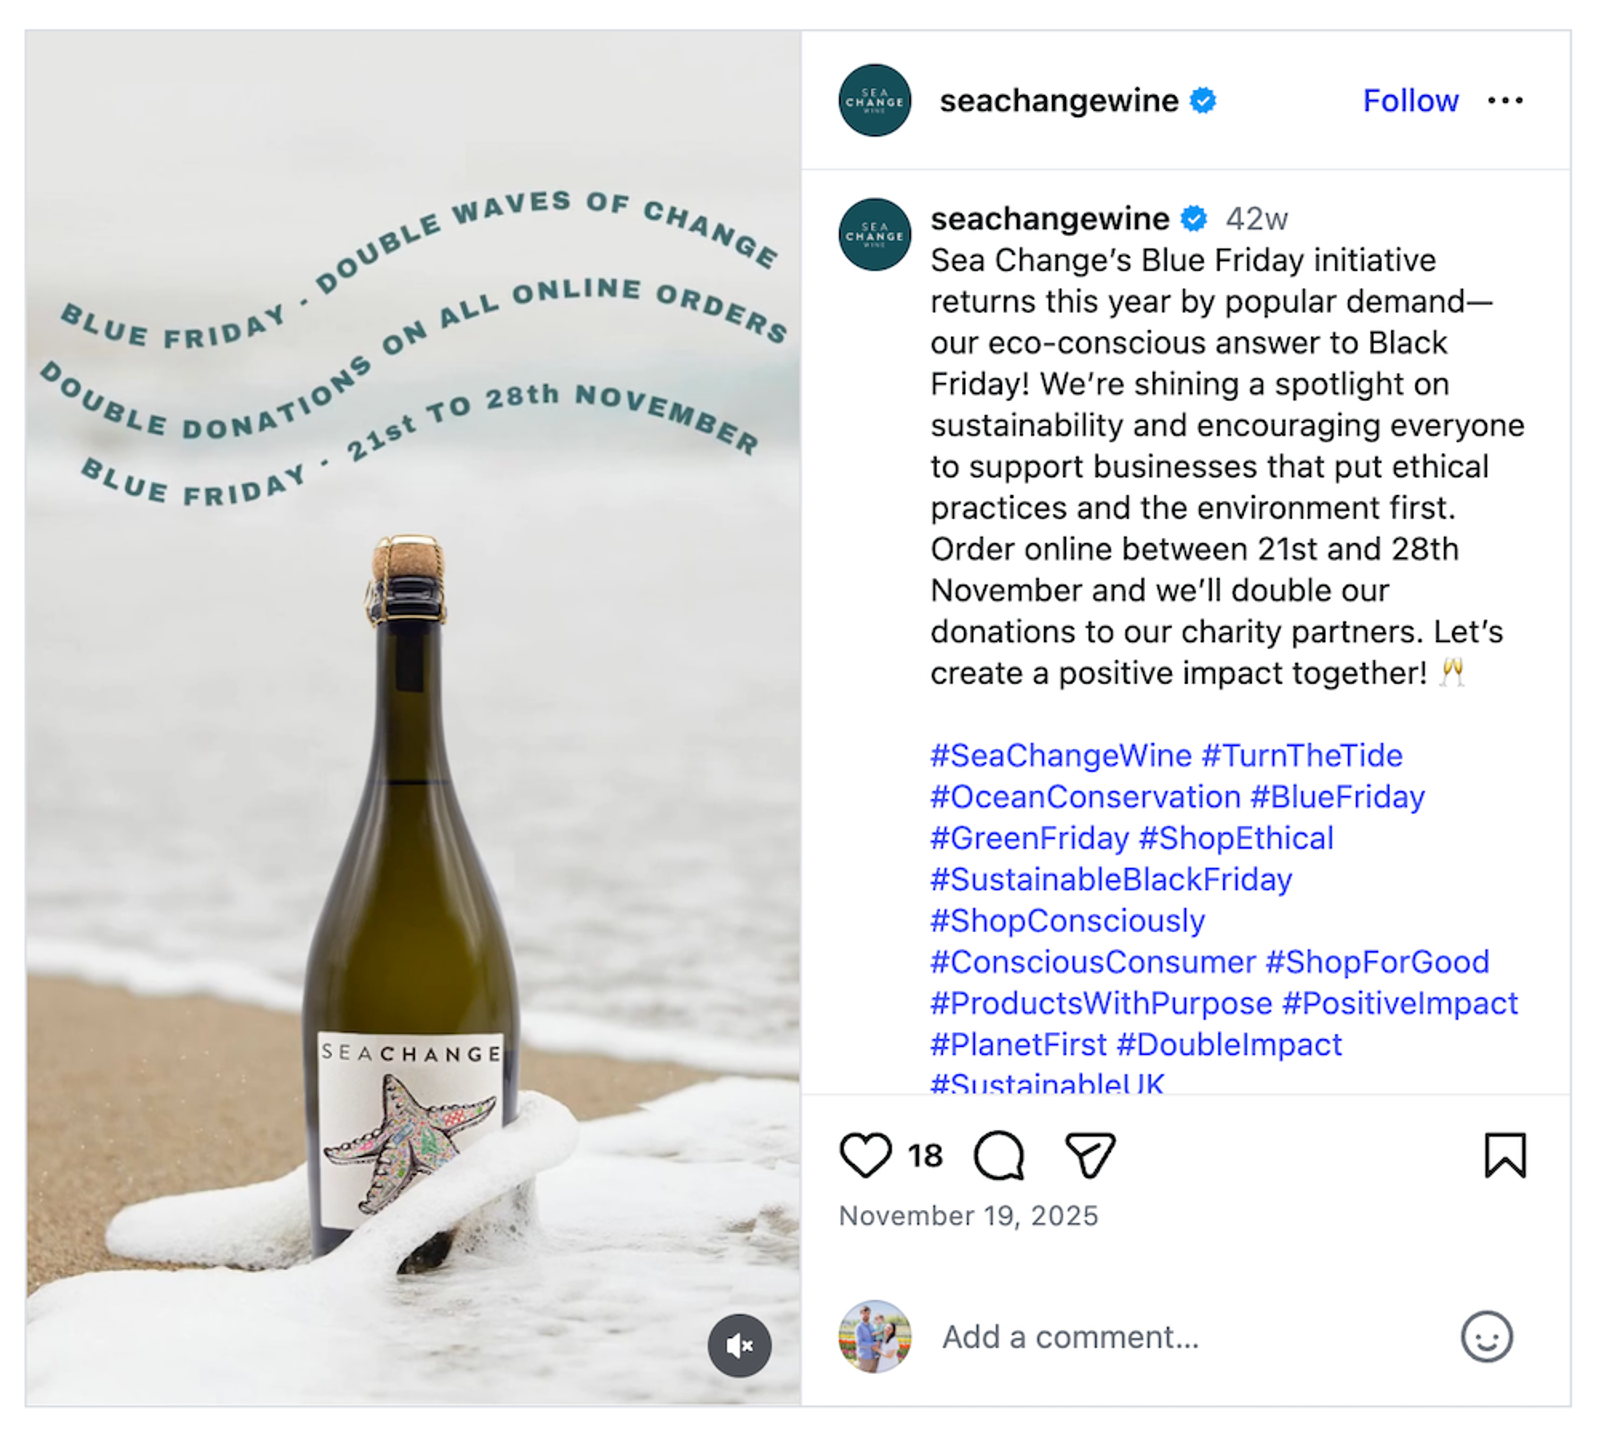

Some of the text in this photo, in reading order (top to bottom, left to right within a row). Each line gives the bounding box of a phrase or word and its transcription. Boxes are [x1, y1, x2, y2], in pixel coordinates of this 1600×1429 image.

[845, 98, 904, 107] CHANGE
[861, 88, 889, 97] SEA
[940, 86, 1179, 118] seachangewine
[1365, 87, 1460, 113] Follow
[861, 222, 889, 231] SEA
[931, 204, 1288, 236] seachangewine 42w
[845, 232, 904, 241] CHANGE
[931, 247, 984, 272] Sea
[1143, 247, 1205, 272] Blue
[1216, 246, 1305, 278] Friday
[1315, 246, 1436, 272] initiative
[932, 290, 1036, 313] returns
[1045, 288, 1098, 313] this
[1108, 294, 1171, 319] year
[1182, 288, 1216, 319] by
[1226, 288, 1337, 319] popular
[931, 329, 1448, 355] our eco-conscious answer to Black
[932, 370, 1029, 401] Friday!
[1135, 370, 1238, 401] shining
[1249, 377, 1264, 396] a
[1276, 370, 1404, 401] spotlight
[1414, 377, 1449, 396] on
[931, 412, 1525, 443] sustainability and encouraging everyone
[930, 453, 1488, 484] to support businesses that put ethical
[932, 494, 1455, 525] practices and the environment first.
[931, 536, 1459, 561] Order online between 21st and 28th
[932, 577, 1083, 602] November
[1093, 577, 1145, 602] and
[1232, 577, 1332, 602] double
[1342, 583, 1390, 602] our
[931, 618, 1075, 644] donations
[1085, 621, 1114, 644] to
[1124, 625, 1172, 644] our
[1182, 618, 1282, 649] charity
[1293, 621, 1423, 649] partners.
[931, 659, 1426, 690] create a positive impact together!
[930, 742, 1403, 773] #SeaChangeWine #TurnTheTide
[930, 783, 1425, 814] #OceanConservation #BlueFriday
[930, 825, 1333, 855] #GreenFriday #ShopEthical
[930, 866, 1293, 897] #SustainableBlackFriday
[930, 907, 1206, 938] #ShopConsciously
[930, 949, 1489, 979] #ConsciousConsumer #ShopForGood
[930, 990, 1518, 1020] #ProductsWithPurpose #PositiveImpact
[930, 1031, 1342, 1062] #PlanetFirst #DoubleImpact
[930, 1072, 1165, 1094] #SustainableUK
[908, 1143, 943, 1168] 18
[840, 1204, 1098, 1231] November 19, 2025
[943, 1324, 999, 1349] Add
[1010, 1330, 1025, 1349] a
